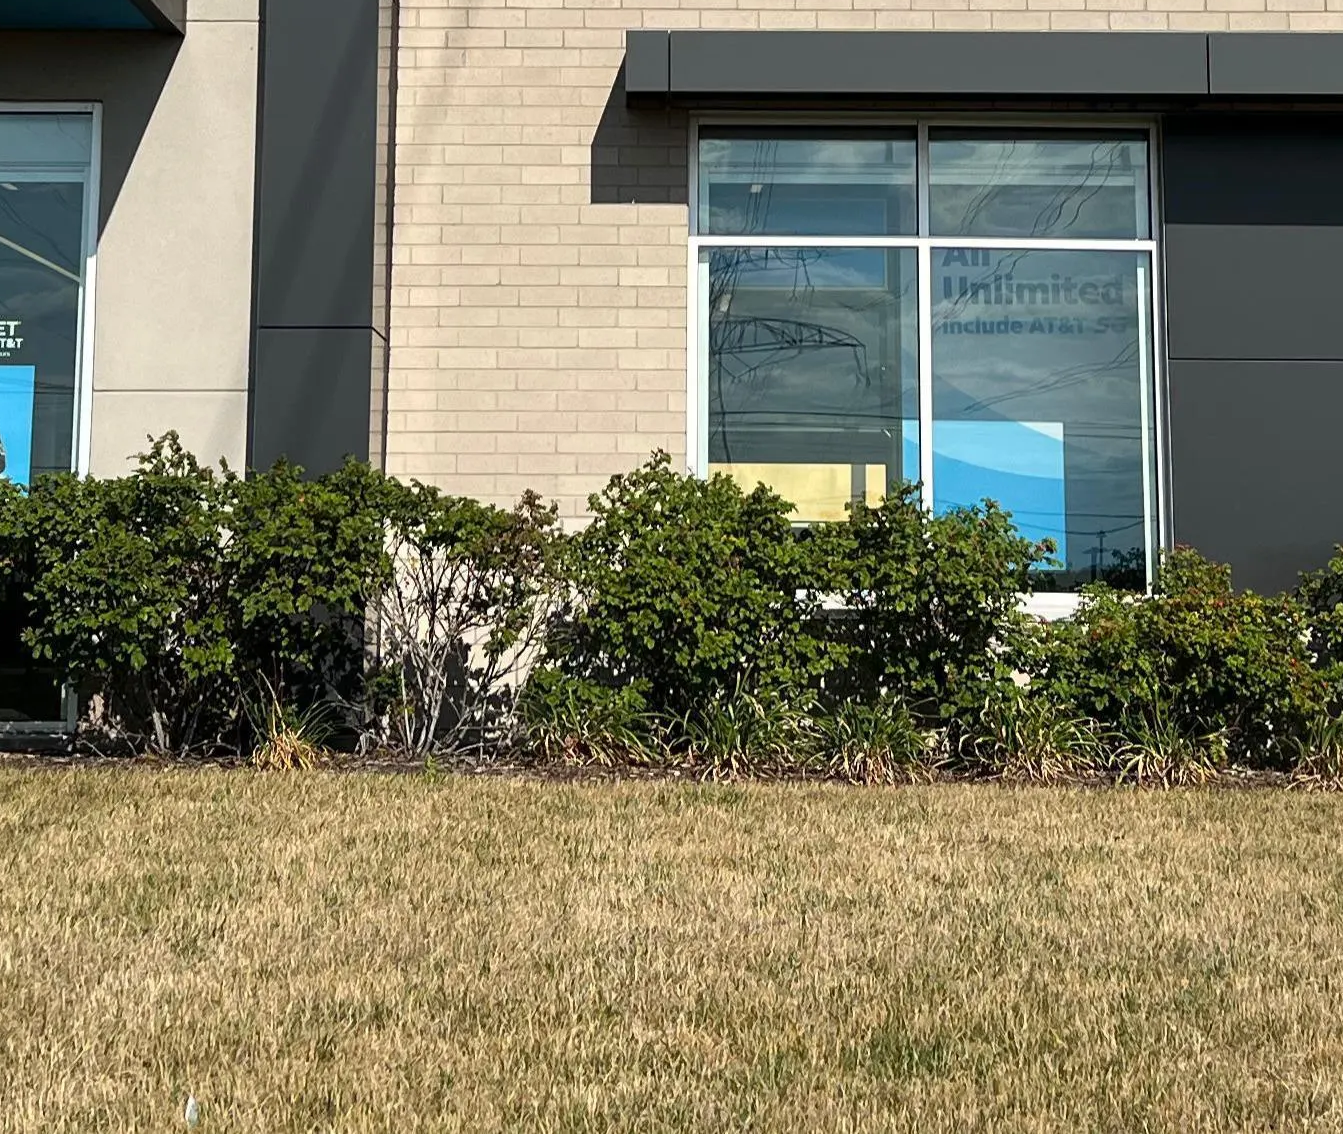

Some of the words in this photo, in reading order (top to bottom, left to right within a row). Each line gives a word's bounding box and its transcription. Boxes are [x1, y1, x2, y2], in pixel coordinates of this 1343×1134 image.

[942, 249, 990, 267] All
[943, 273, 1123, 306] Unlimited
[942, 316, 1023, 335] include
[1029, 317, 1084, 335] AT&T
